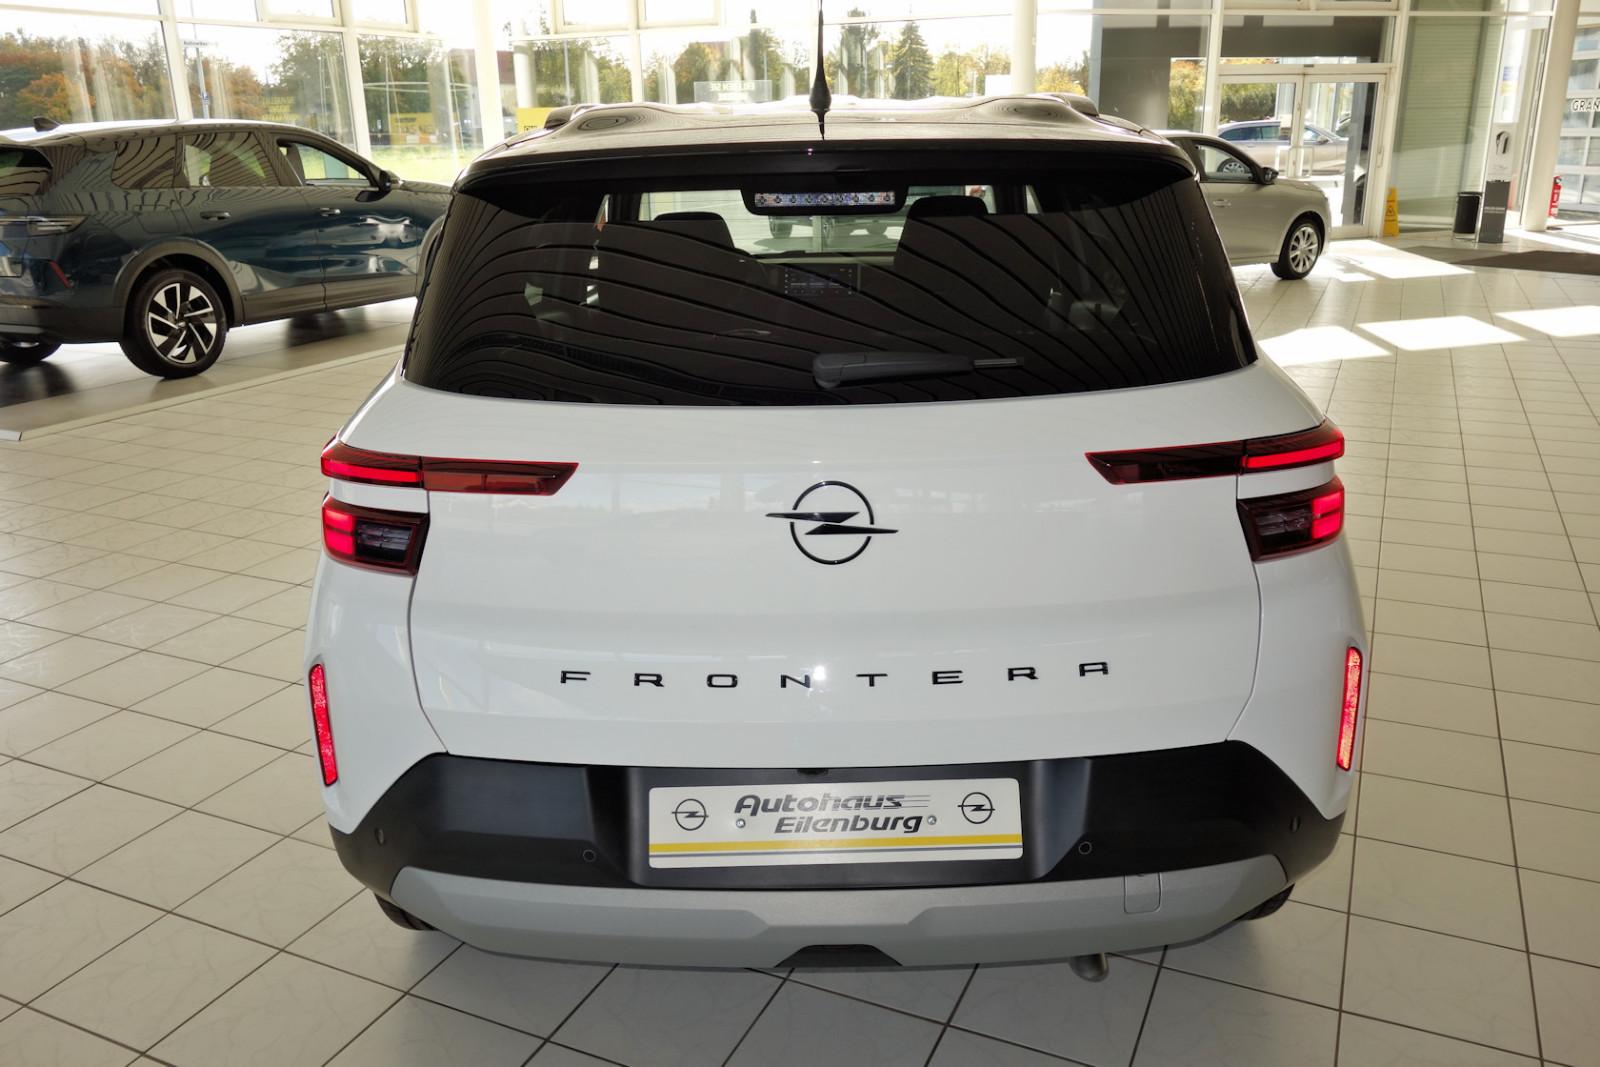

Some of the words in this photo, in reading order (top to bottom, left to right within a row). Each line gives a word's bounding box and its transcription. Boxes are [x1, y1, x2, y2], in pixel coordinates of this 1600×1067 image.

[560, 662, 1109, 689] FRONTERA
[734, 793, 906, 816] Autohaus
[775, 815, 923, 834] Eilenburg
